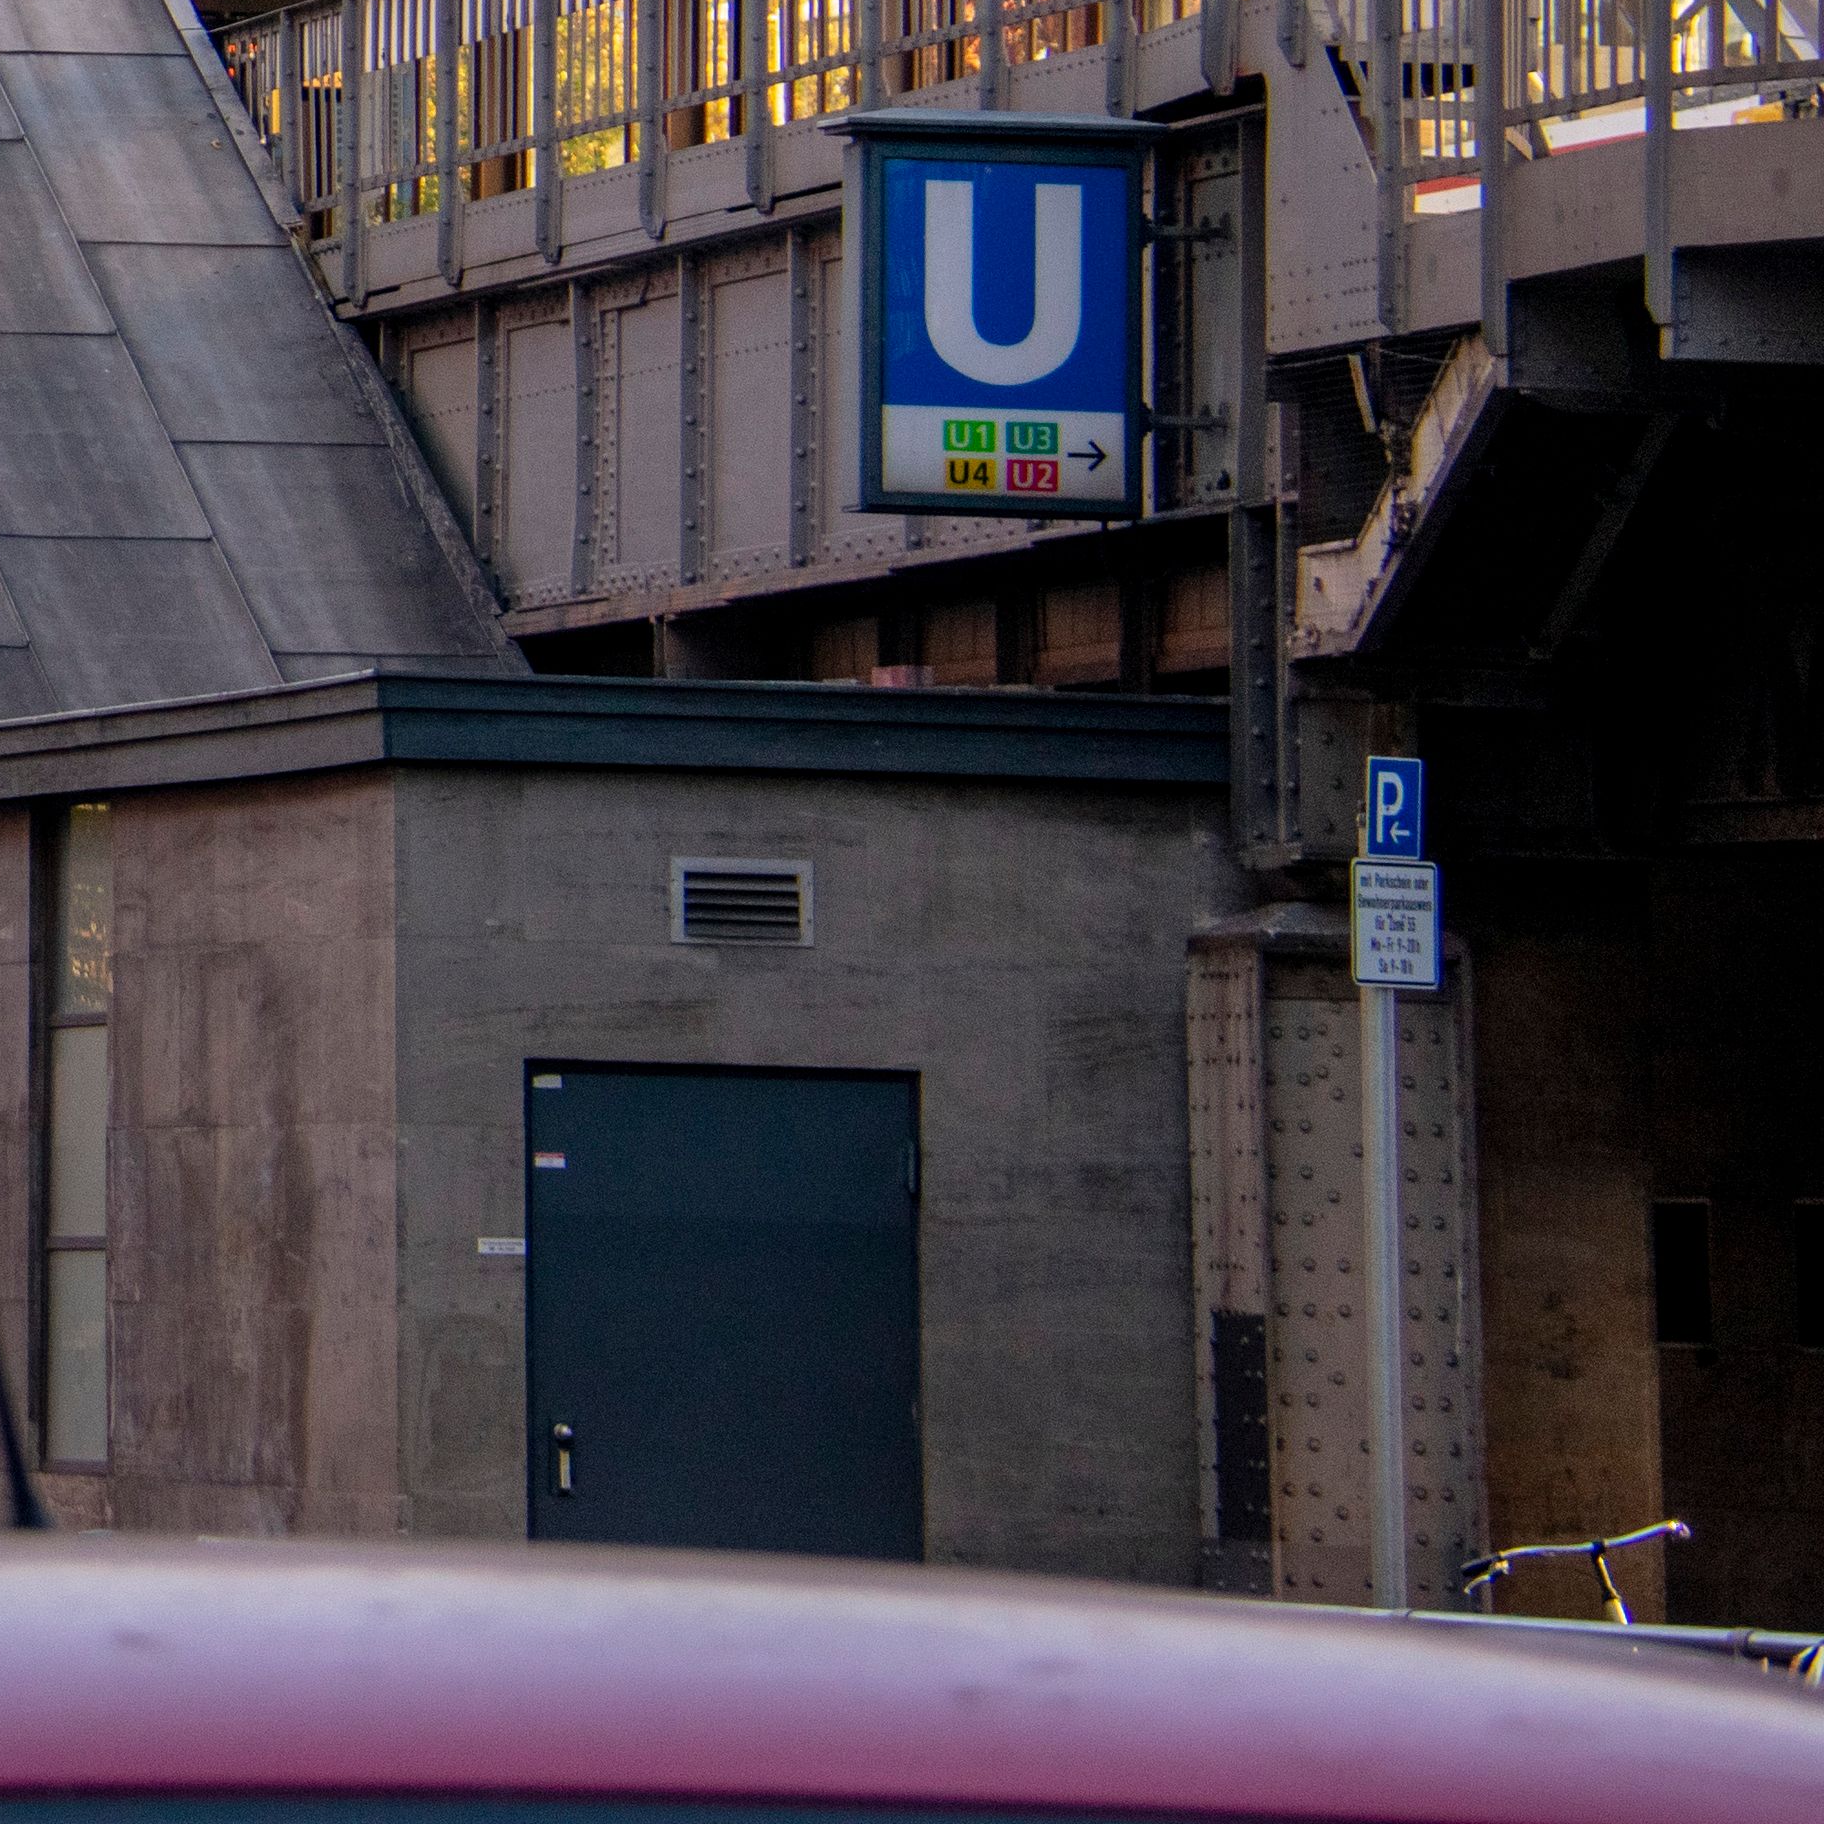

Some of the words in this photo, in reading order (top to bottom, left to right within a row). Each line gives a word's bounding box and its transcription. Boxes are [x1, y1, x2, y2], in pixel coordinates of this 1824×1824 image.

[924, 179, 1082, 386] U
[949, 422, 989, 450] U1
[1013, 425, 1055, 451] U3
[949, 461, 991, 487] U4
[1013, 463, 1056, 490] U2
[1376, 771, 1404, 844] P
